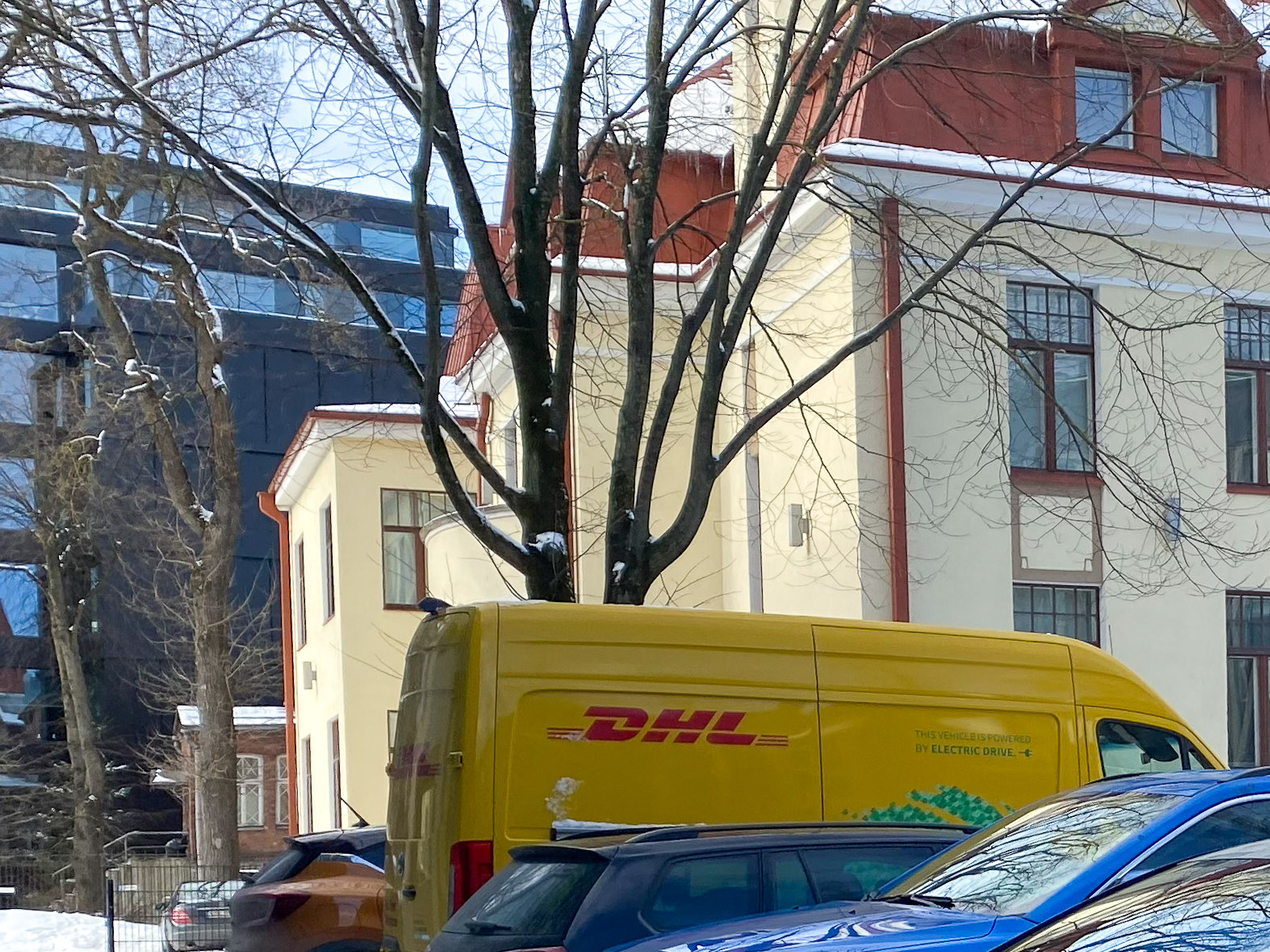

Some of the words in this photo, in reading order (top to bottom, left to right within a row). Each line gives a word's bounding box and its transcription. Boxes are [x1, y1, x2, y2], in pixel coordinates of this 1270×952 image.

[583, 705, 758, 746] DHL
[914, 729, 936, 739] THIS
[938, 730, 975, 741] VEHICLE
[976, 732, 987, 741] IS
[987, 733, 1031, 744] POWERED
[915, 743, 929, 753] BY
[931, 744, 981, 755] ELECTRIC
